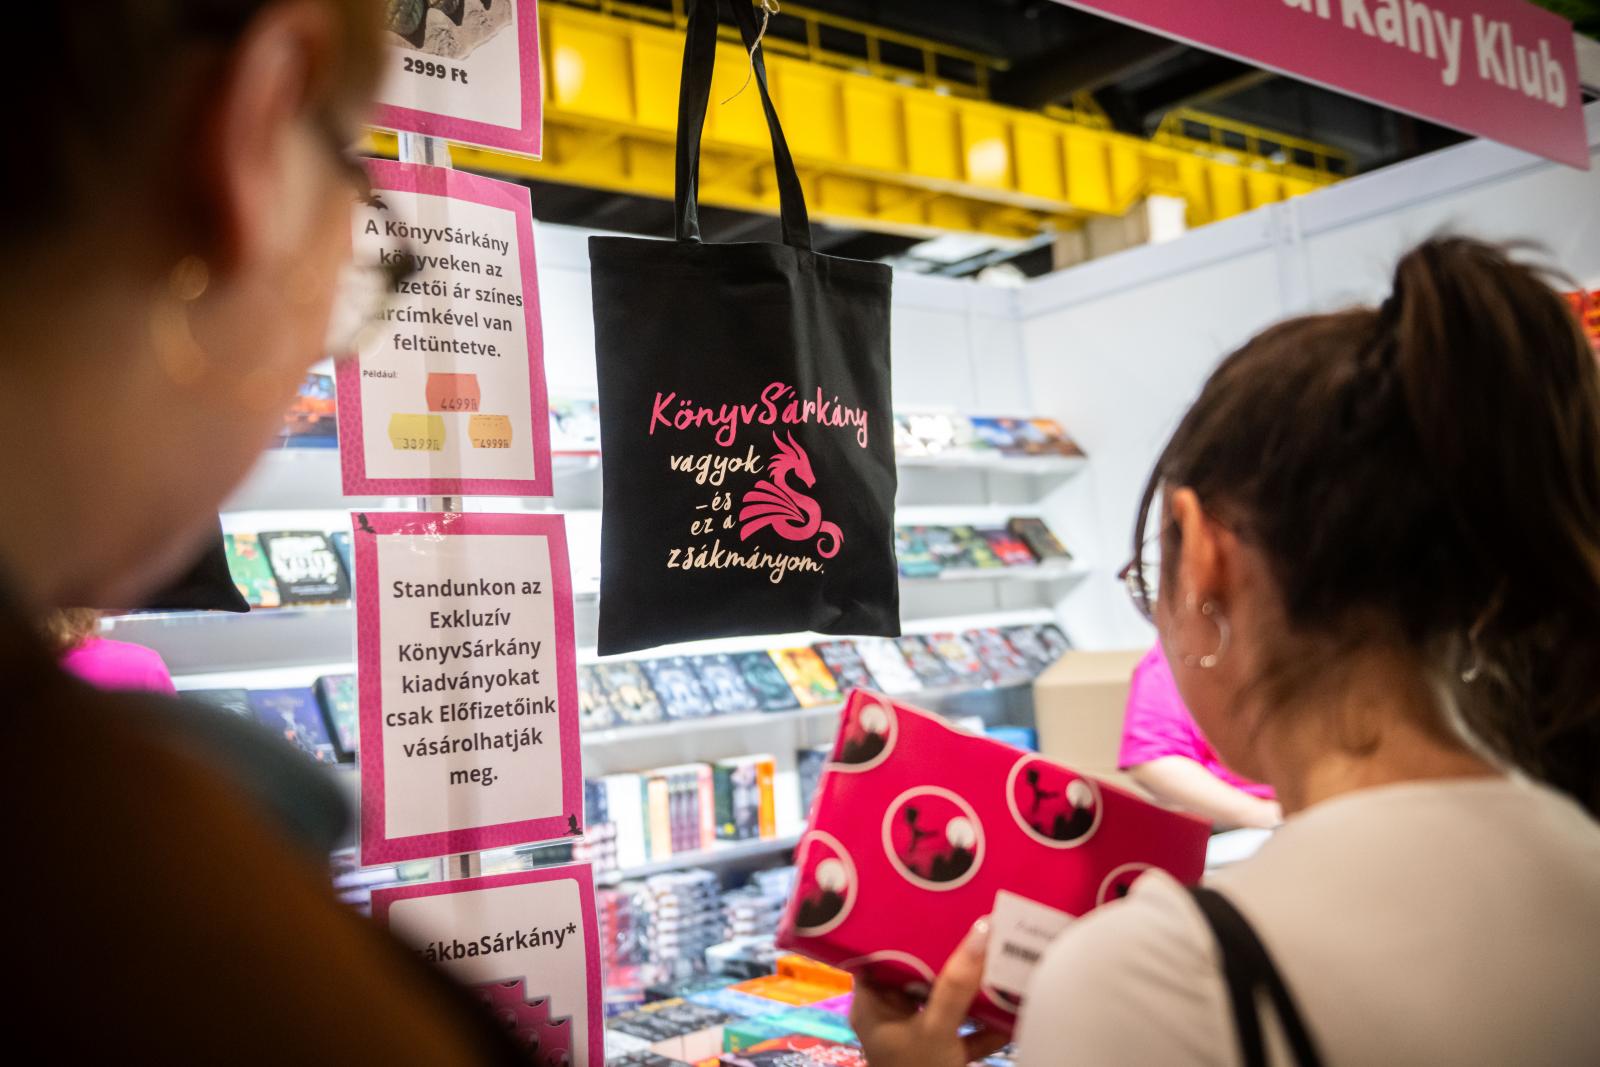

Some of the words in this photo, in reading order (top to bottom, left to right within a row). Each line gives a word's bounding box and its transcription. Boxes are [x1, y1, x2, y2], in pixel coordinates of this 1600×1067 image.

[403, 57, 447, 79] 2999
[451, 67, 469, 84] Ft
[1472, 13, 1567, 108] Klub
[364, 219, 379, 236] A
[385, 220, 509, 256] KönyvSárkány
[485, 263, 503, 278] az
[453, 282, 471, 300] ár
[475, 287, 523, 307] színes
[483, 316, 513, 332] van
[393, 333, 501, 357] feltüntetve.
[650, 382, 868, 449] KönyvSárkány
[670, 445, 764, 487] vagyok
[690, 518, 714, 536] ez
[722, 514, 737, 530] a
[667, 538, 825, 584] zsákmányom.
[392, 578, 516, 599] Standunkon
[521, 580, 542, 595] az
[429, 608, 511, 629] Exkluzív
[398, 638, 541, 665] KönyvSárkány
[402, 668, 540, 694] kiadványokat
[386, 706, 434, 727] csak
[439, 696, 556, 723] Előfizetőink
[403, 727, 543, 758] vásárolhatják
[449, 766, 499, 787] meg.
